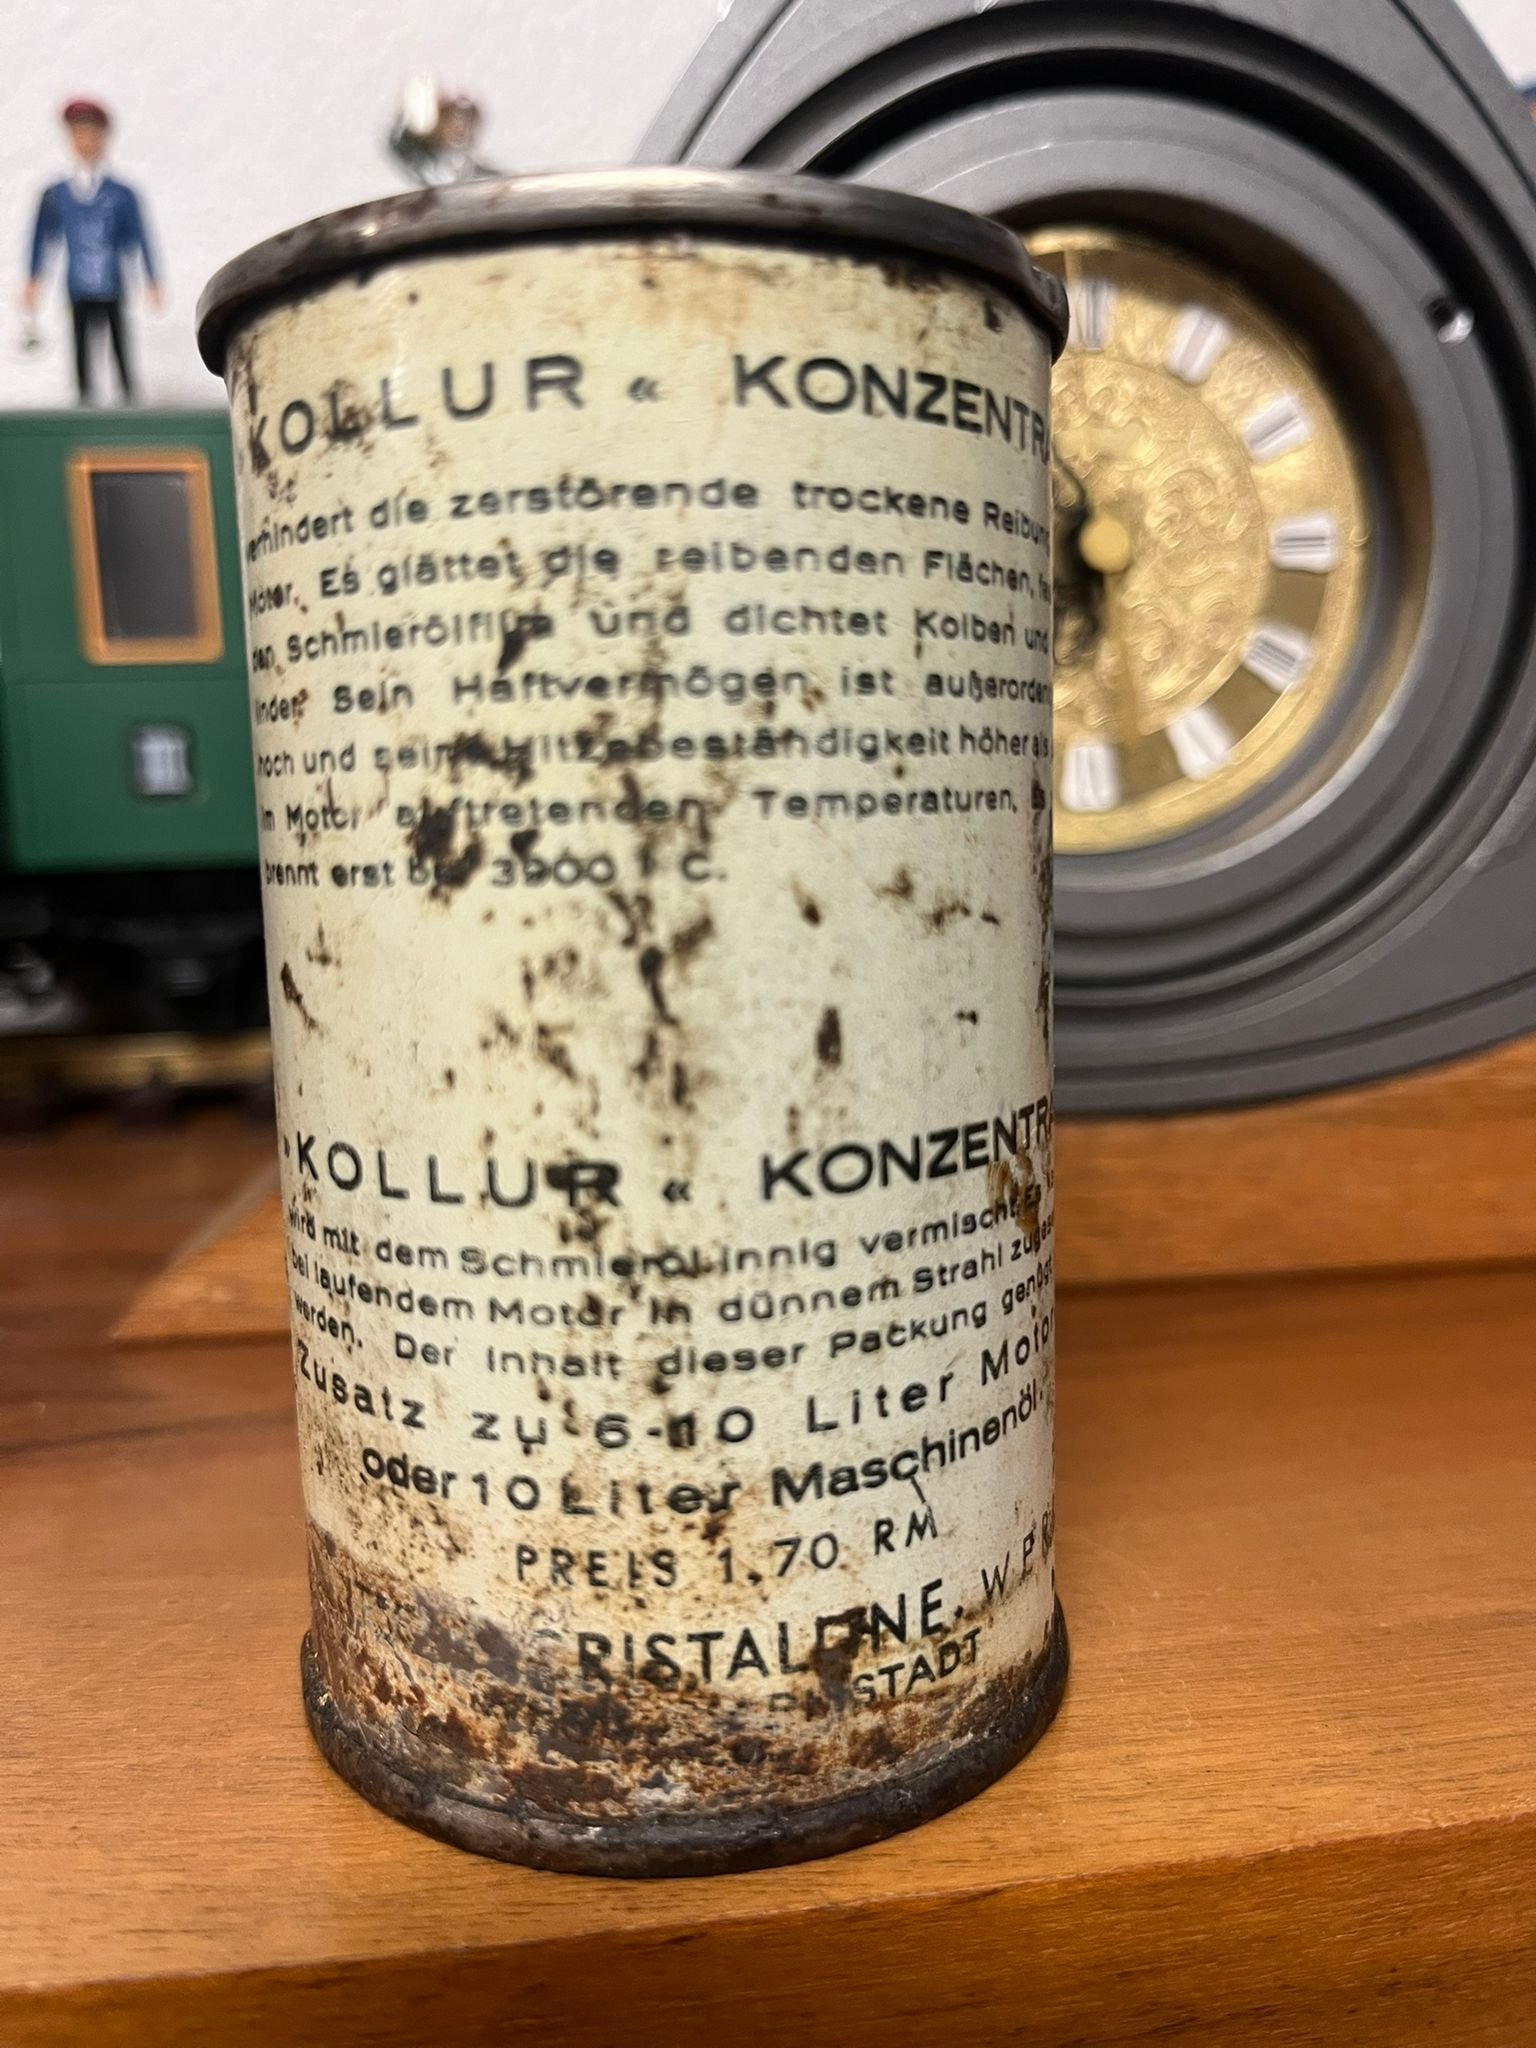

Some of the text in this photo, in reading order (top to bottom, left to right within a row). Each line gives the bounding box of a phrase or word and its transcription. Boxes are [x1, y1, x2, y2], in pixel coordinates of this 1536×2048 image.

[249, 354, 584, 474] KOLLUR
[370, 497, 428, 531] die
[450, 475, 758, 519] zerstörende
[793, 480, 970, 524] trockene
[320, 567, 361, 598] Es
[377, 551, 522, 597] glättet
[545, 542, 620, 577] die
[655, 542, 904, 576] reibenden
[924, 550, 1035, 597] Flächen,
[591, 606, 690, 637] und
[724, 606, 888, 637] dichtet
[916, 609, 1016, 645] Kolben
[333, 682, 413, 714] Sein
[453, 665, 808, 704] Haftvermögen
[841, 667, 894, 697] ist
[303, 742, 355, 774] und
[959, 725, 1027, 758] höher
[752, 788, 1018, 821] Temperaturen,
[330, 860, 395, 889] erst
[297, 1131, 623, 1208] KOLLUR
[323, 1222, 360, 1257] mit
[375, 1236, 449, 1270] dem
[722, 1237, 838, 1272] innig
[314, 1261, 475, 1322] laufendem
[488, 1297, 625, 1328] Motor
[720, 1276, 900, 1322] dünnem
[911, 1242, 1002, 1294] Strahl
[394, 1331, 457, 1367] Der
[486, 1345, 621, 1378] Inhalt
[658, 1341, 805, 1376] dieser
[829, 1300, 989, 1358] Packung
[297, 1337, 426, 1430] Zusatz
[471, 1411, 548, 1446] zu
[806, 1372, 954, 1433] Liter
[361, 1379, 1044, 1516] oder 10 Liter Maschinenöl.
[516, 1506, 939, 1590] PREIS 1.70 RM
